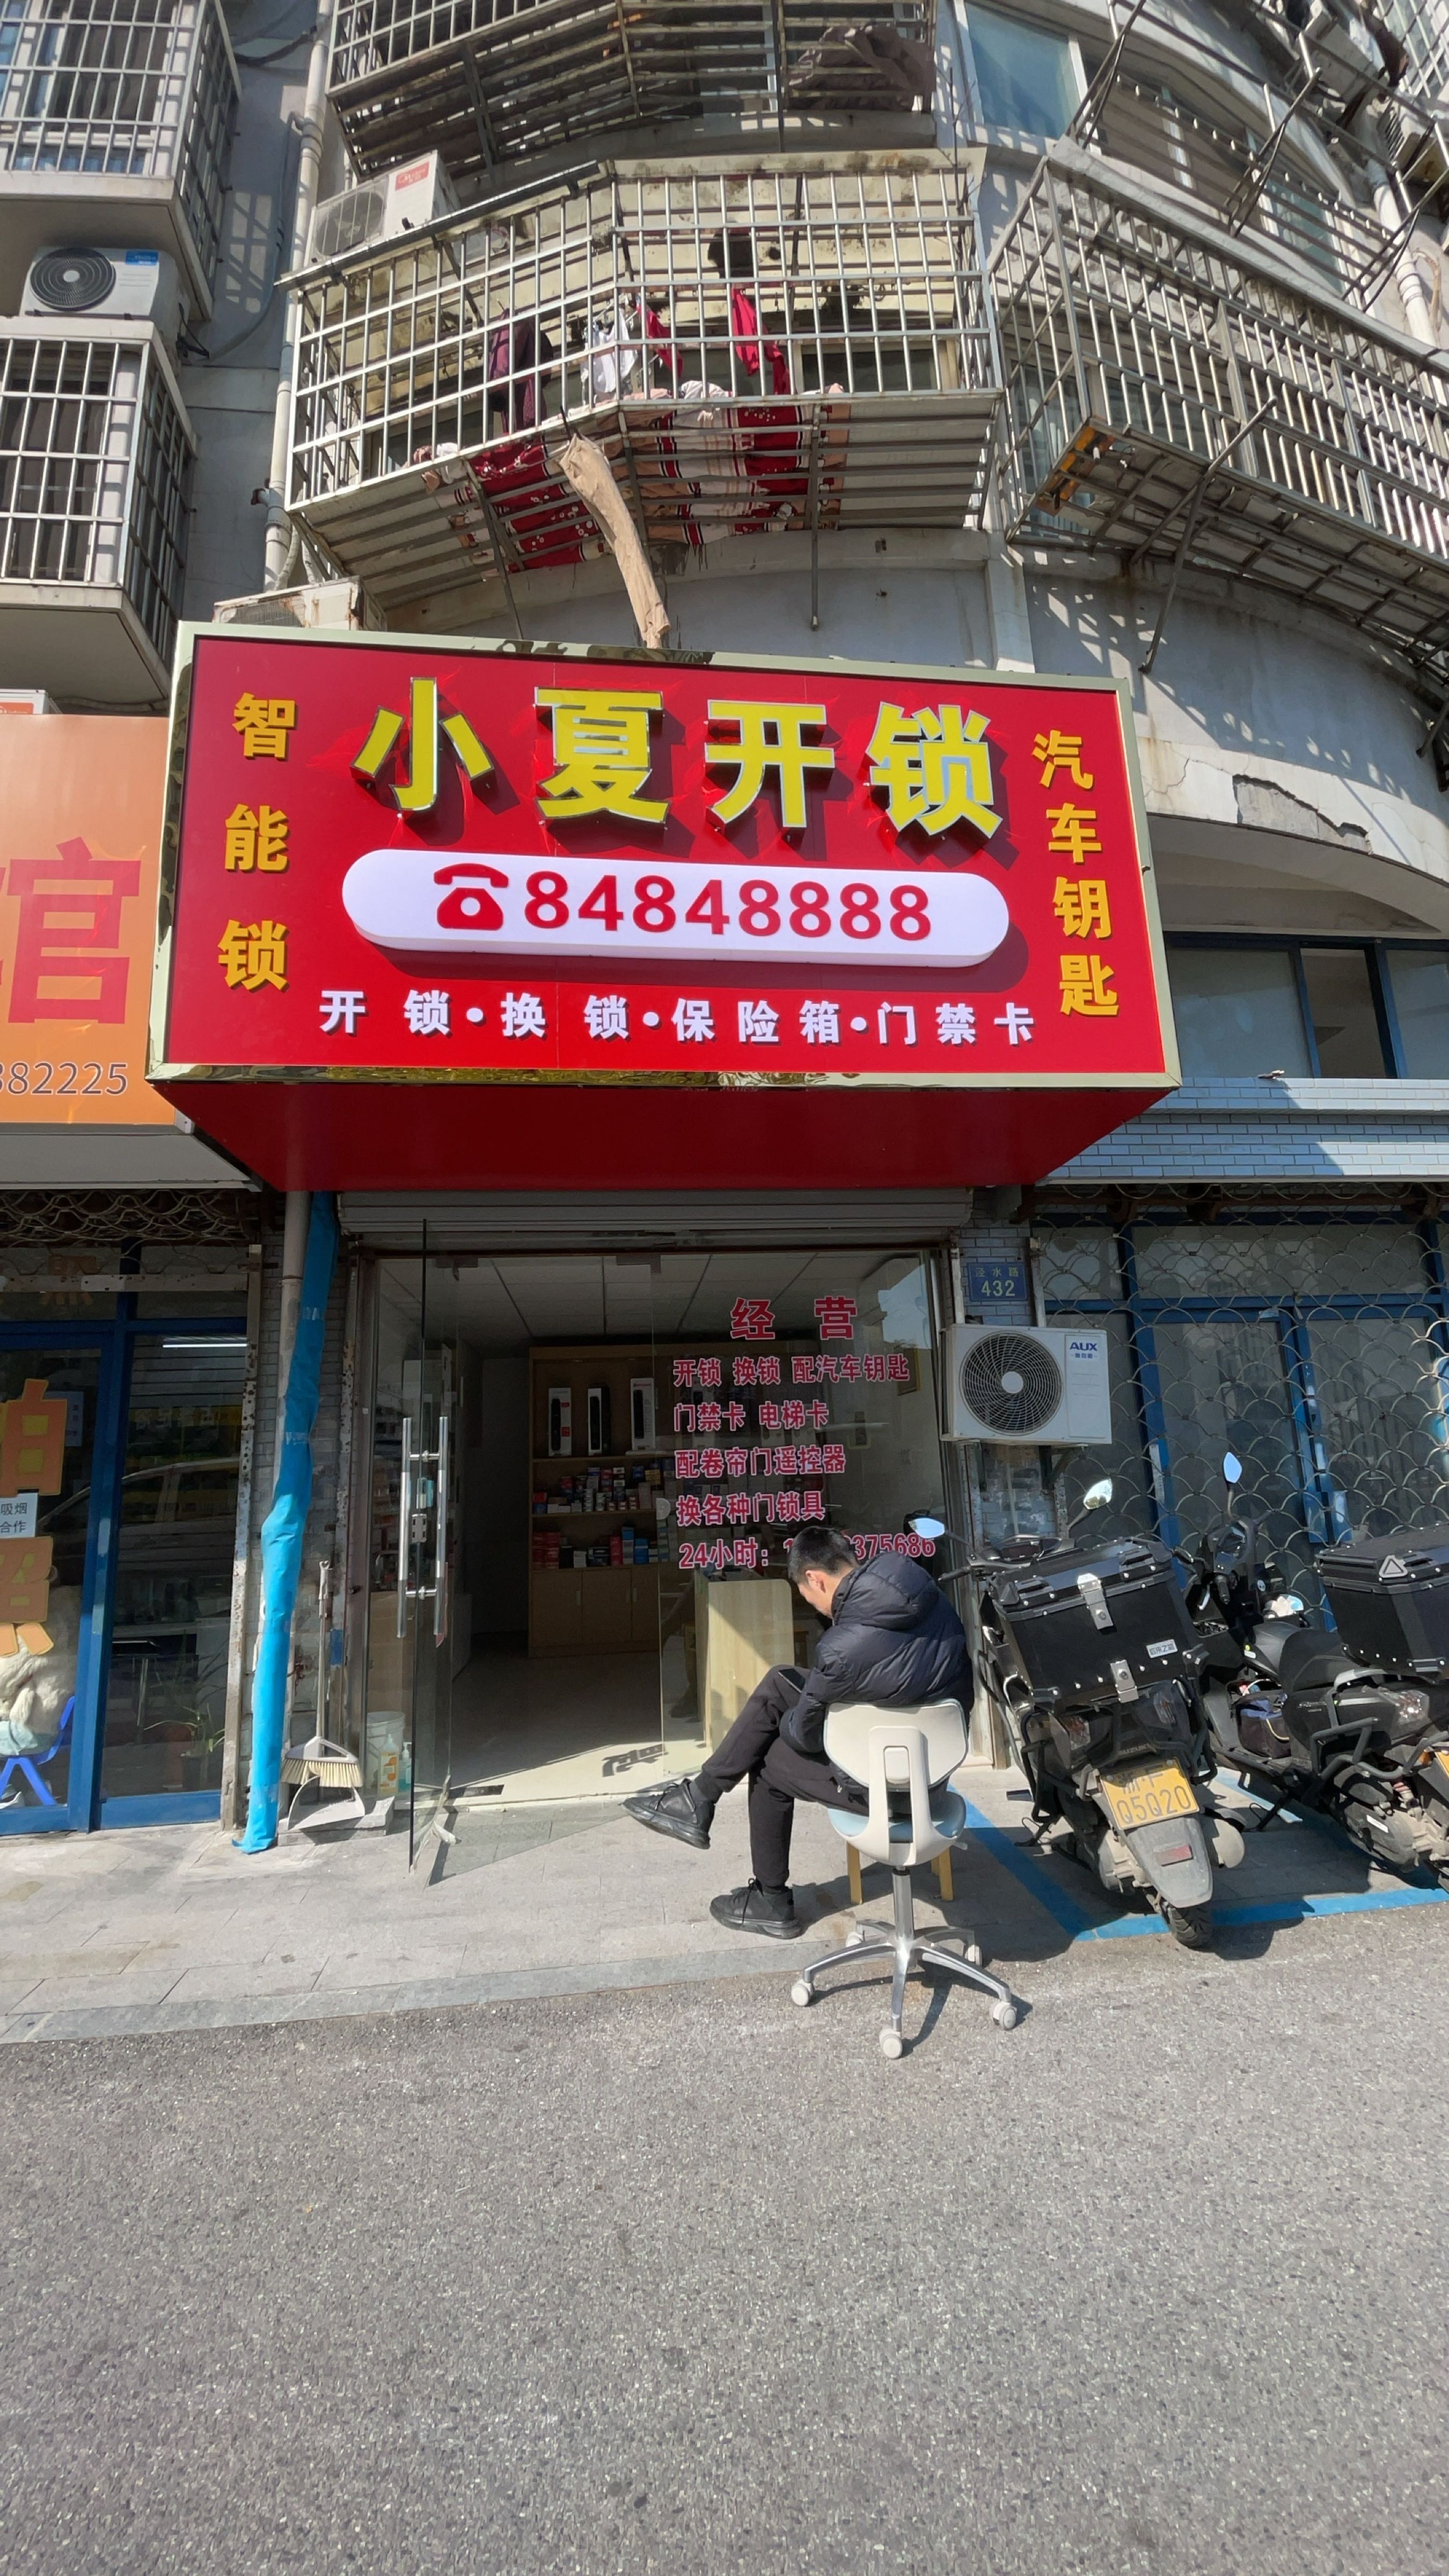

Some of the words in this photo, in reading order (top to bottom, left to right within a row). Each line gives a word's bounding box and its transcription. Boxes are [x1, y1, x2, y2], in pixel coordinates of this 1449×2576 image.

[350, 677, 1002, 838] 小夏开锁
[218, 692, 297, 990] 智能锁
[1032, 729, 1118, 1016] 汽车钥匙
[524, 870, 931, 940] 84848888
[0, 1061, 128, 1095] 82225
[981, 1280, 1015, 1297] 432
[730, 1296, 857, 1340] 经营
[1070, 1342, 1098, 1351] AUX
[673, 1357, 722, 1387] 开锁
[733, 1356, 781, 1386] 换锁
[791, 1353, 911, 1383] 配汽车钥匙
[673, 1401, 746, 1432] 门禁卡
[758, 1399, 829, 1430] 电梯卡
[674, 1444, 846, 1479] 配卷帘门遥控器
[676, 1490, 826, 1526] 换各种门锁具
[1, 1520, 26, 1533] 合作
